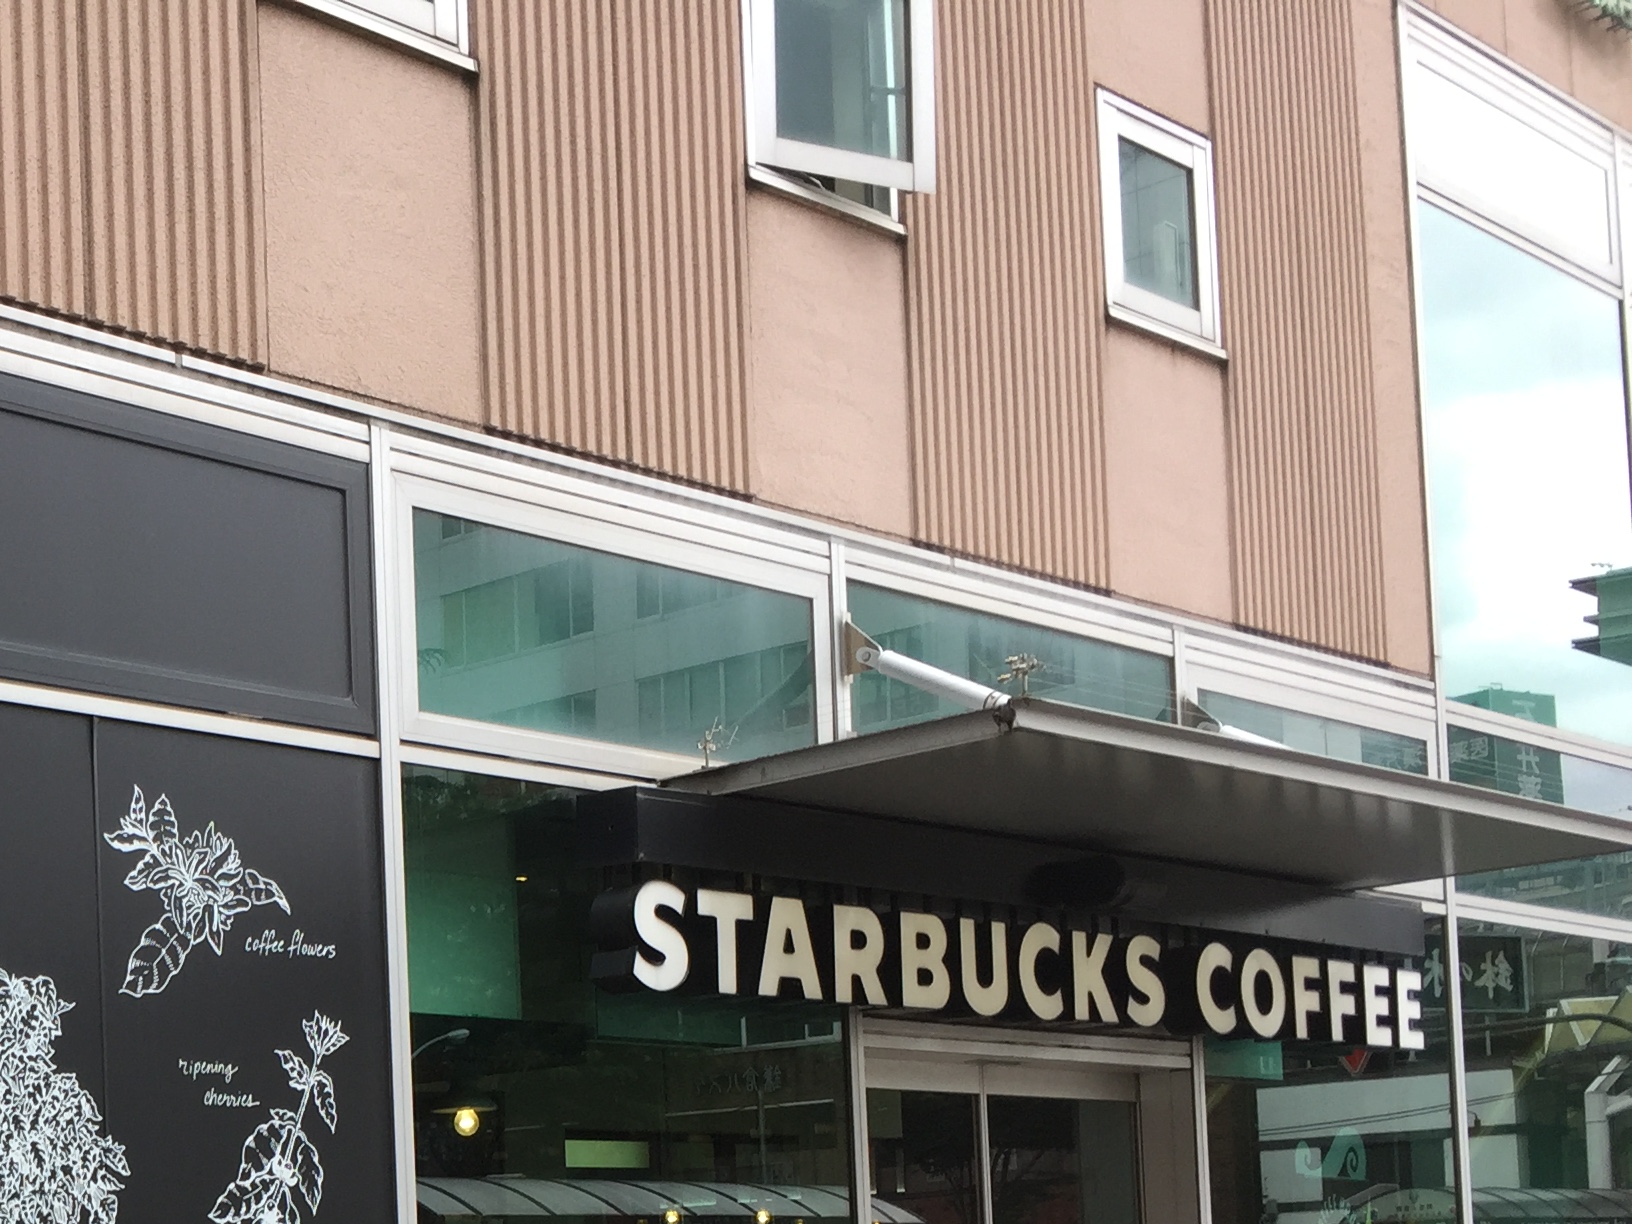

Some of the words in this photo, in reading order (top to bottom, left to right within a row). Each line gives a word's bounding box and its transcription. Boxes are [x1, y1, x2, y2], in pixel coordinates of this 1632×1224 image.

[244, 928, 285, 957] coffee
[287, 928, 337, 959] flowers
[632, 880, 1166, 1027] STARBUCKS
[1195, 941, 1425, 1050] COFFEE
[178, 1058, 239, 1084] ripening
[203, 1086, 261, 1108] cherries
